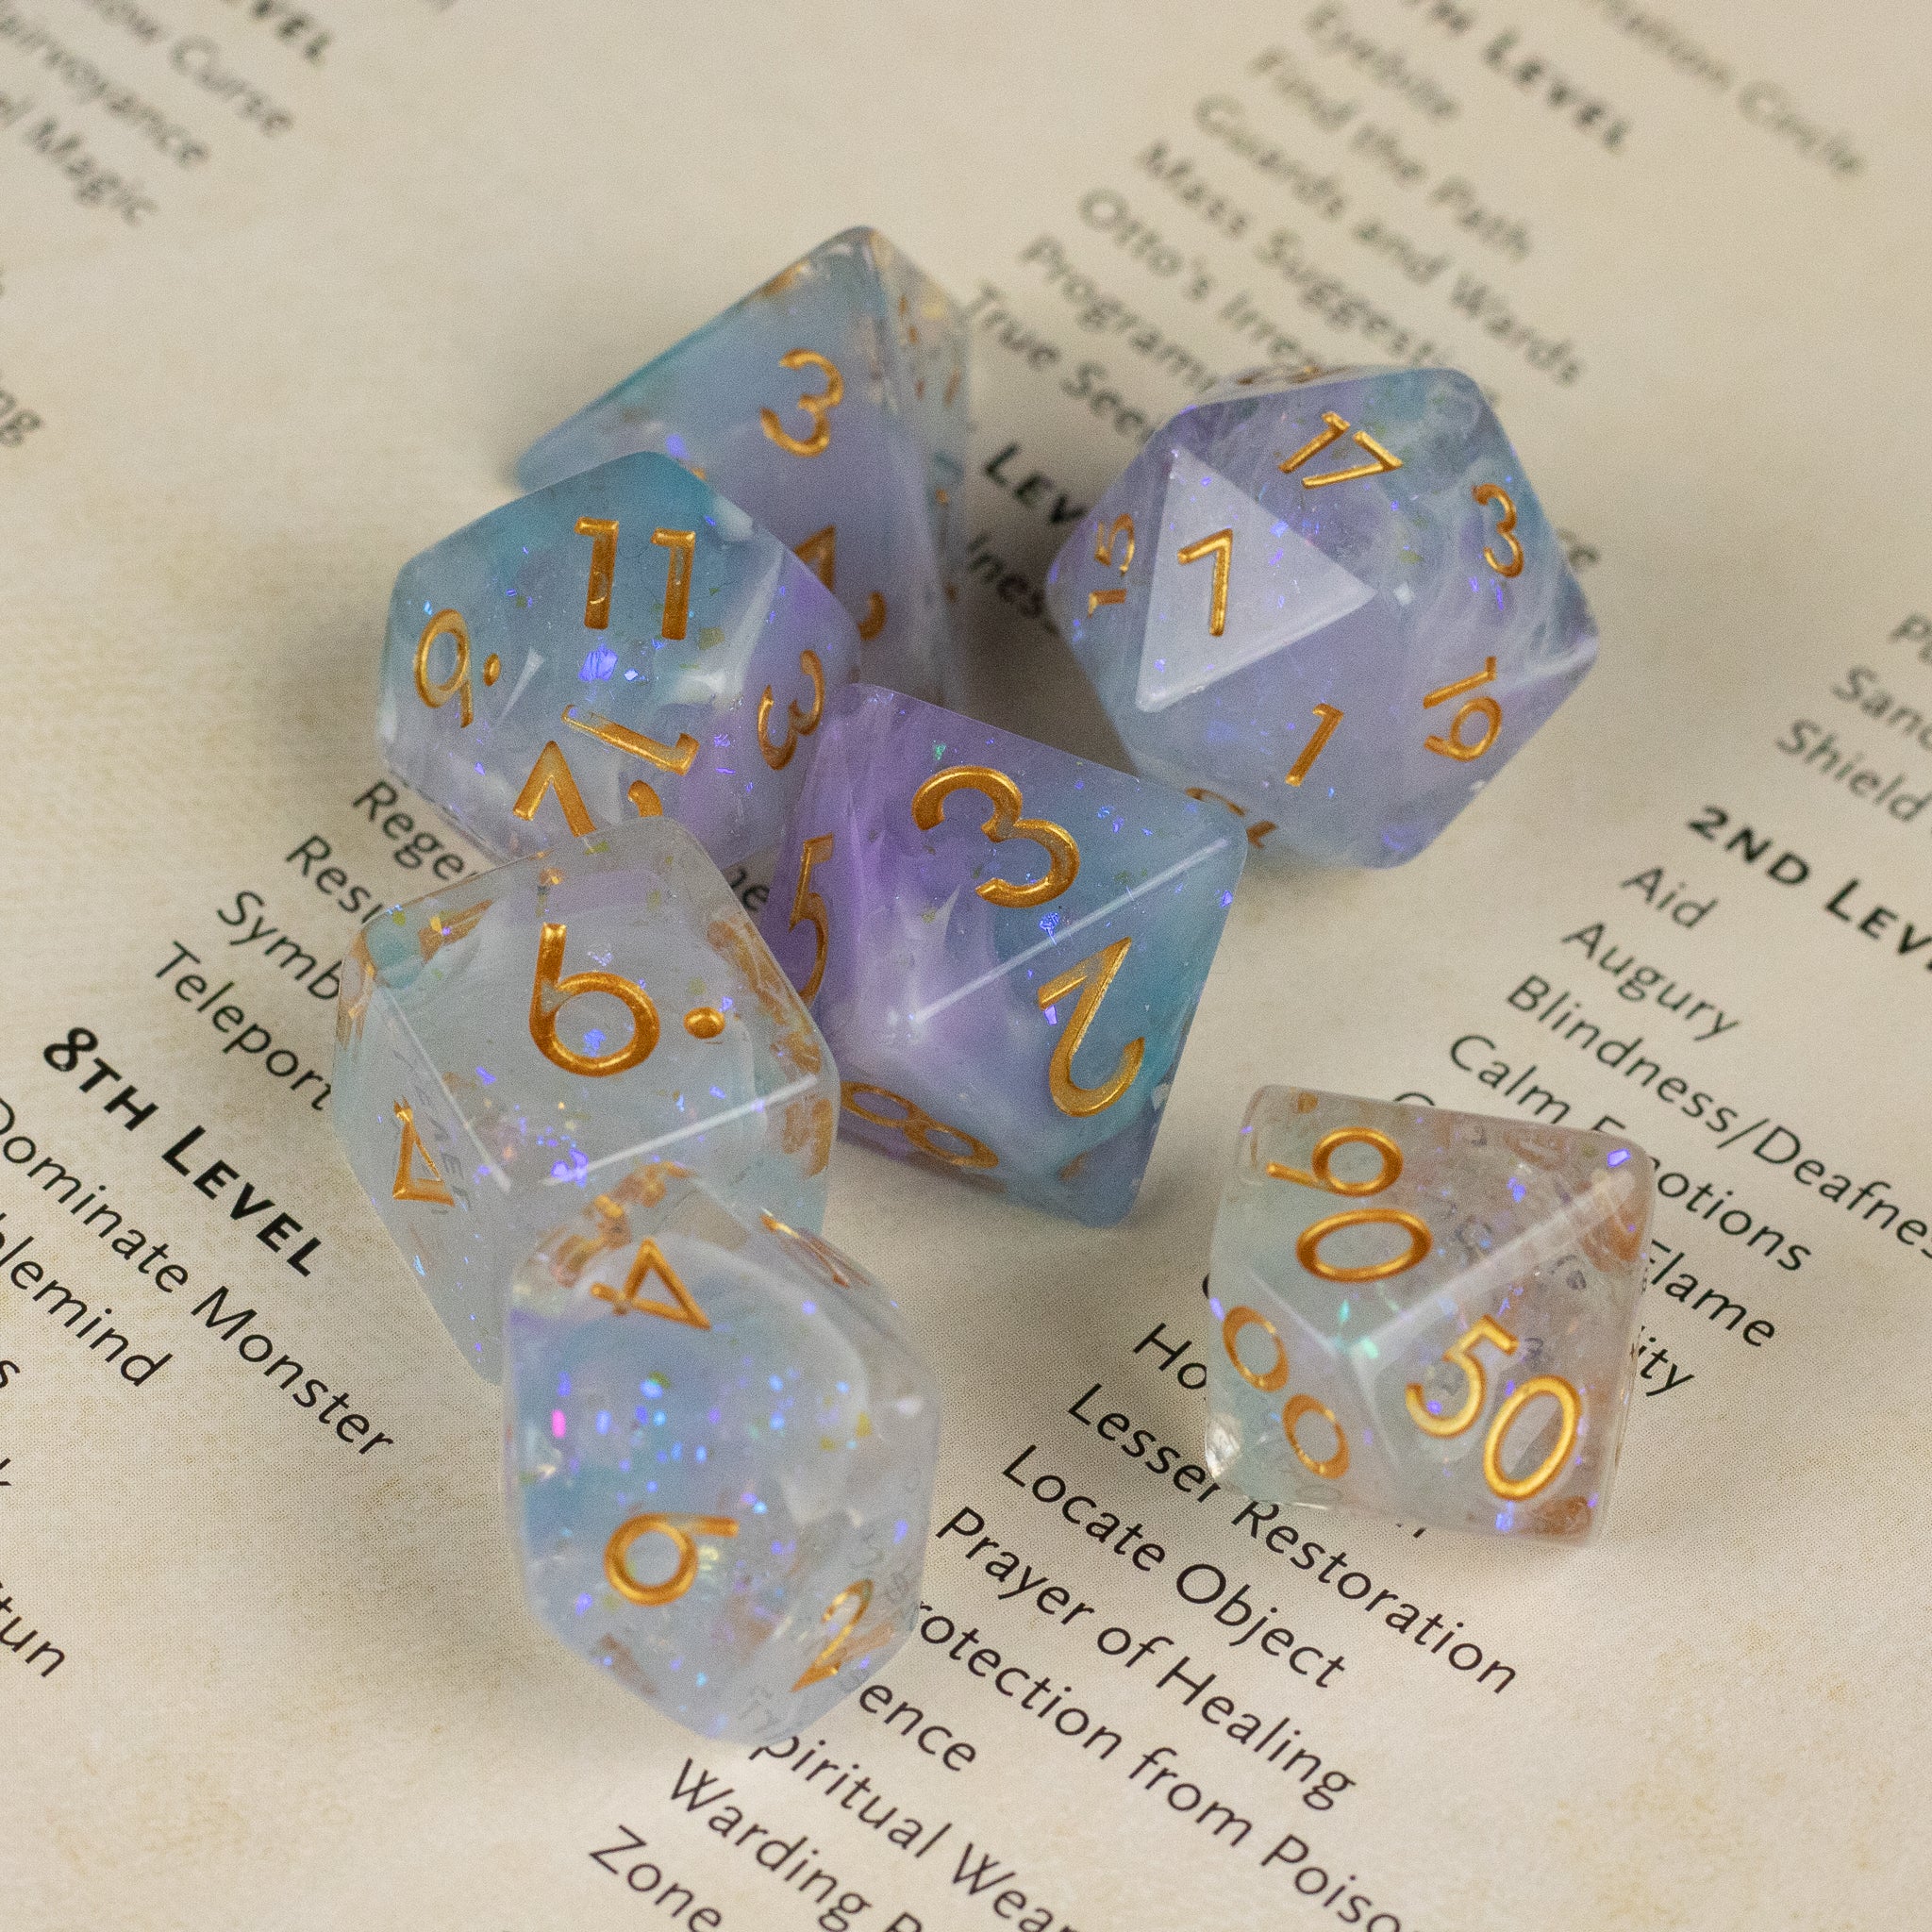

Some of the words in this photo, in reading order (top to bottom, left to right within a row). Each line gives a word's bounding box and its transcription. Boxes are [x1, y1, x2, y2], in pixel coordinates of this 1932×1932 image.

[1135, 137, 1250, 240] Mass
[1246, 42, 1361, 133] Find
[1347, 121, 1426, 184] the
[1428, 175, 1532, 263] Path
[1075, 187, 1215, 302] Otto's
[1193, 92, 1347, 224] Guards
[1351, 215, 1454, 287] and
[1450, 271, 1589, 388] Wards
[963, 282, 1063, 371] True
[759, 348, 844, 457] 3
[1278, 411, 1404, 491] 17
[574, 516, 696, 641] 11
[1176, 528, 1233, 637] 7
[1472, 483, 1524, 578] 3
[758, 649, 825, 771] 3
[1285, 703, 1344, 787] 1
[1775, 717, 1932, 823] Shield
[352, 779, 480, 881] Rege
[911, 765, 1080, 908] 3
[1687, 803, 1810, 887] 2ND
[1823, 877, 1932, 974] LEV
[790, 833, 834, 1005] 5
[1619, 865, 1719, 931] Aid
[1038, 937, 1144, 1117] 2
[1561, 921, 1741, 1041] Augury
[841, 1081, 998, 1170] 8
[1448, 1034, 1573, 1124] Calm
[1506, 974, 1932, 1260] Blindness/Deafne
[42, 1026, 159, 1131] 8TH
[161, 1125, 324, 1277] LEVEL
[0, 1213, 174, 1388] lemind
[591, 1239, 711, 1331] 4
[192, 1286, 395, 1456] Monster
[1222, 1306, 1350, 1479] 00
[1405, 1314, 1582, 1502] 50
[1002, 1444, 1167, 1573] Locate
[1175, 1563, 1347, 1689] Object
[1067, 1383, 1222, 1503] Lesser
[1231, 1501, 1517, 1695] Restoration
[935, 1506, 1095, 1626] Prayer
[1096, 1635, 1174, 1668] of
[1156, 1656, 1357, 1811] Healing
[671, 1758, 872, 1932] Warding
[1128, 1746, 1253, 1848] from
[590, 1824, 723, 1932] Zone
[953, 1842, 1081, 1932] Wea
